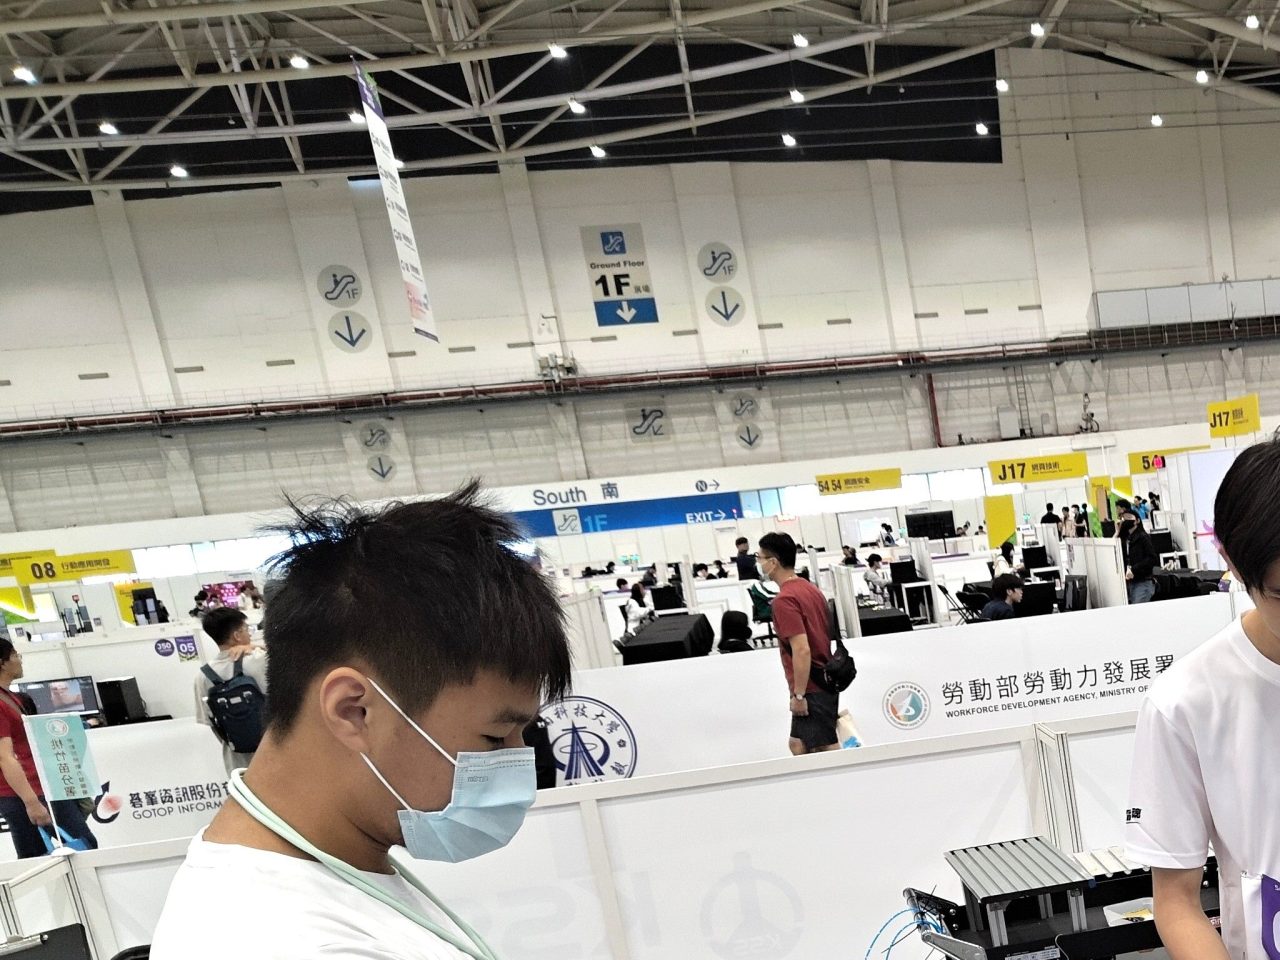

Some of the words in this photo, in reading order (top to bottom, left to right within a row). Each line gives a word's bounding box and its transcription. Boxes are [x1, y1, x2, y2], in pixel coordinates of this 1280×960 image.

[590, 261, 621, 270] Ground
[623, 259, 645, 268] Floor
[722, 265, 734, 276] 1F
[595, 273, 631, 297] 1F
[346, 288, 359, 300] 1F
[1210, 411, 1229, 428] J17
[998, 463, 1026, 480] J17
[601, 482, 619, 499] 南
[818, 480, 829, 492] 54
[832, 479, 841, 491] 54
[533, 486, 587, 506] South
[585, 514, 608, 531] 1F
[685, 511, 713, 523] EXIT
[30, 562, 56, 579] 08
[180, 643, 195, 652] 05
[946, 703, 999, 718] WORKFORCE
[1001, 697, 1061, 711] DEVELOPMENT
[1063, 691, 1098, 704] AGENCY,
[1100, 687, 1136, 698] MINISTRY
[1137, 684, 1149, 694] OF
[133, 806, 174, 820] GOTOP
